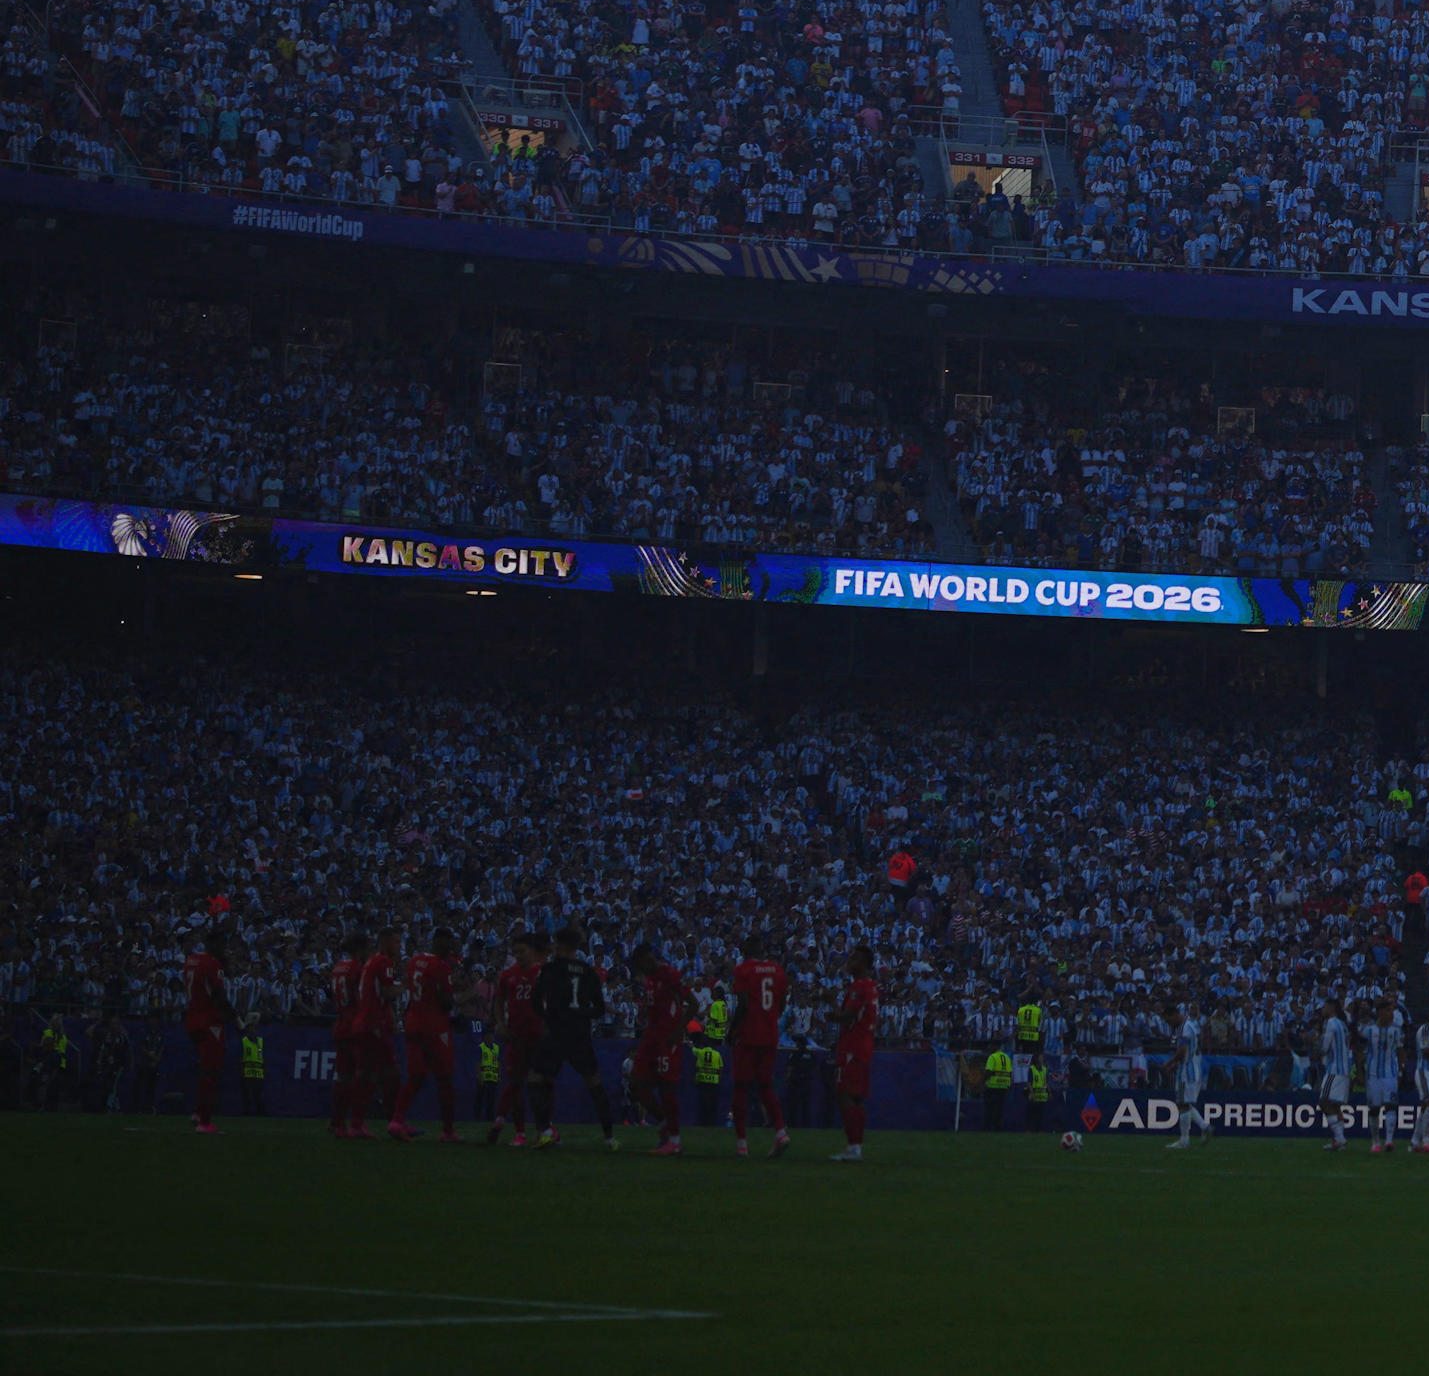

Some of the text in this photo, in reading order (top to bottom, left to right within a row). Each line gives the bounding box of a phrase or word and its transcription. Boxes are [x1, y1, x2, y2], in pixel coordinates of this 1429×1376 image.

[955, 153, 981, 162] 331
[1008, 156, 1034, 165] 332
[232, 205, 364, 241] #FIFAWorldCup
[342, 536, 576, 576] KANSAS CITY
[835, 569, 1222, 612] FIFA WORLD CUP 2026
[516, 984, 532, 1000] 22
[571, 977, 580, 1009] 1
[761, 977, 774, 1011] 6
[295, 1050, 338, 1080] FIF
